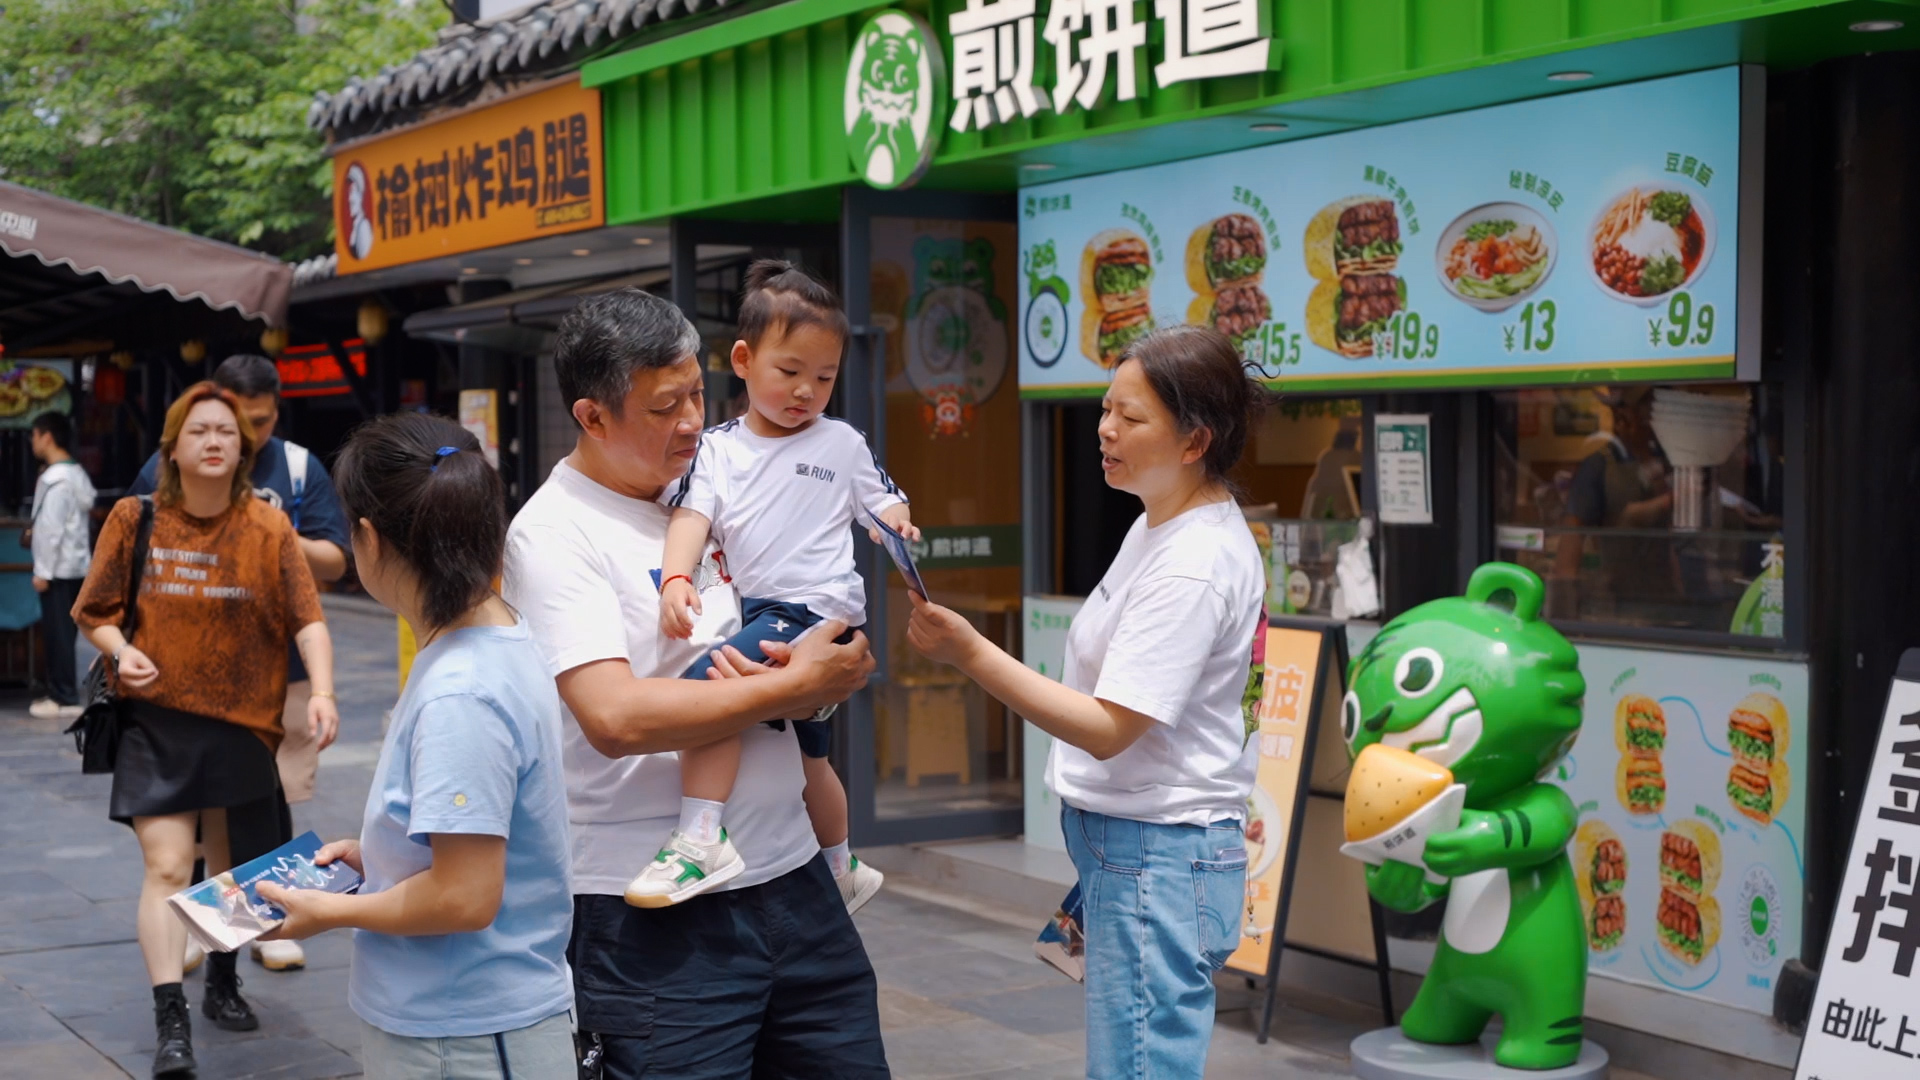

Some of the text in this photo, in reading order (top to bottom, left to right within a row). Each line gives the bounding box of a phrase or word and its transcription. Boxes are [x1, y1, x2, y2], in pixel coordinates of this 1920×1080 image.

[948, 0, 1272, 133] 煎饼道
[377, 112, 590, 241] 榆树炸鸡腿
[1503, 299, 1557, 352] ¥13
[1649, 291, 1714, 347] ¥9.9
[810, 464, 836, 483] RUN
[1821, 997, 1920, 1060] 由此上
